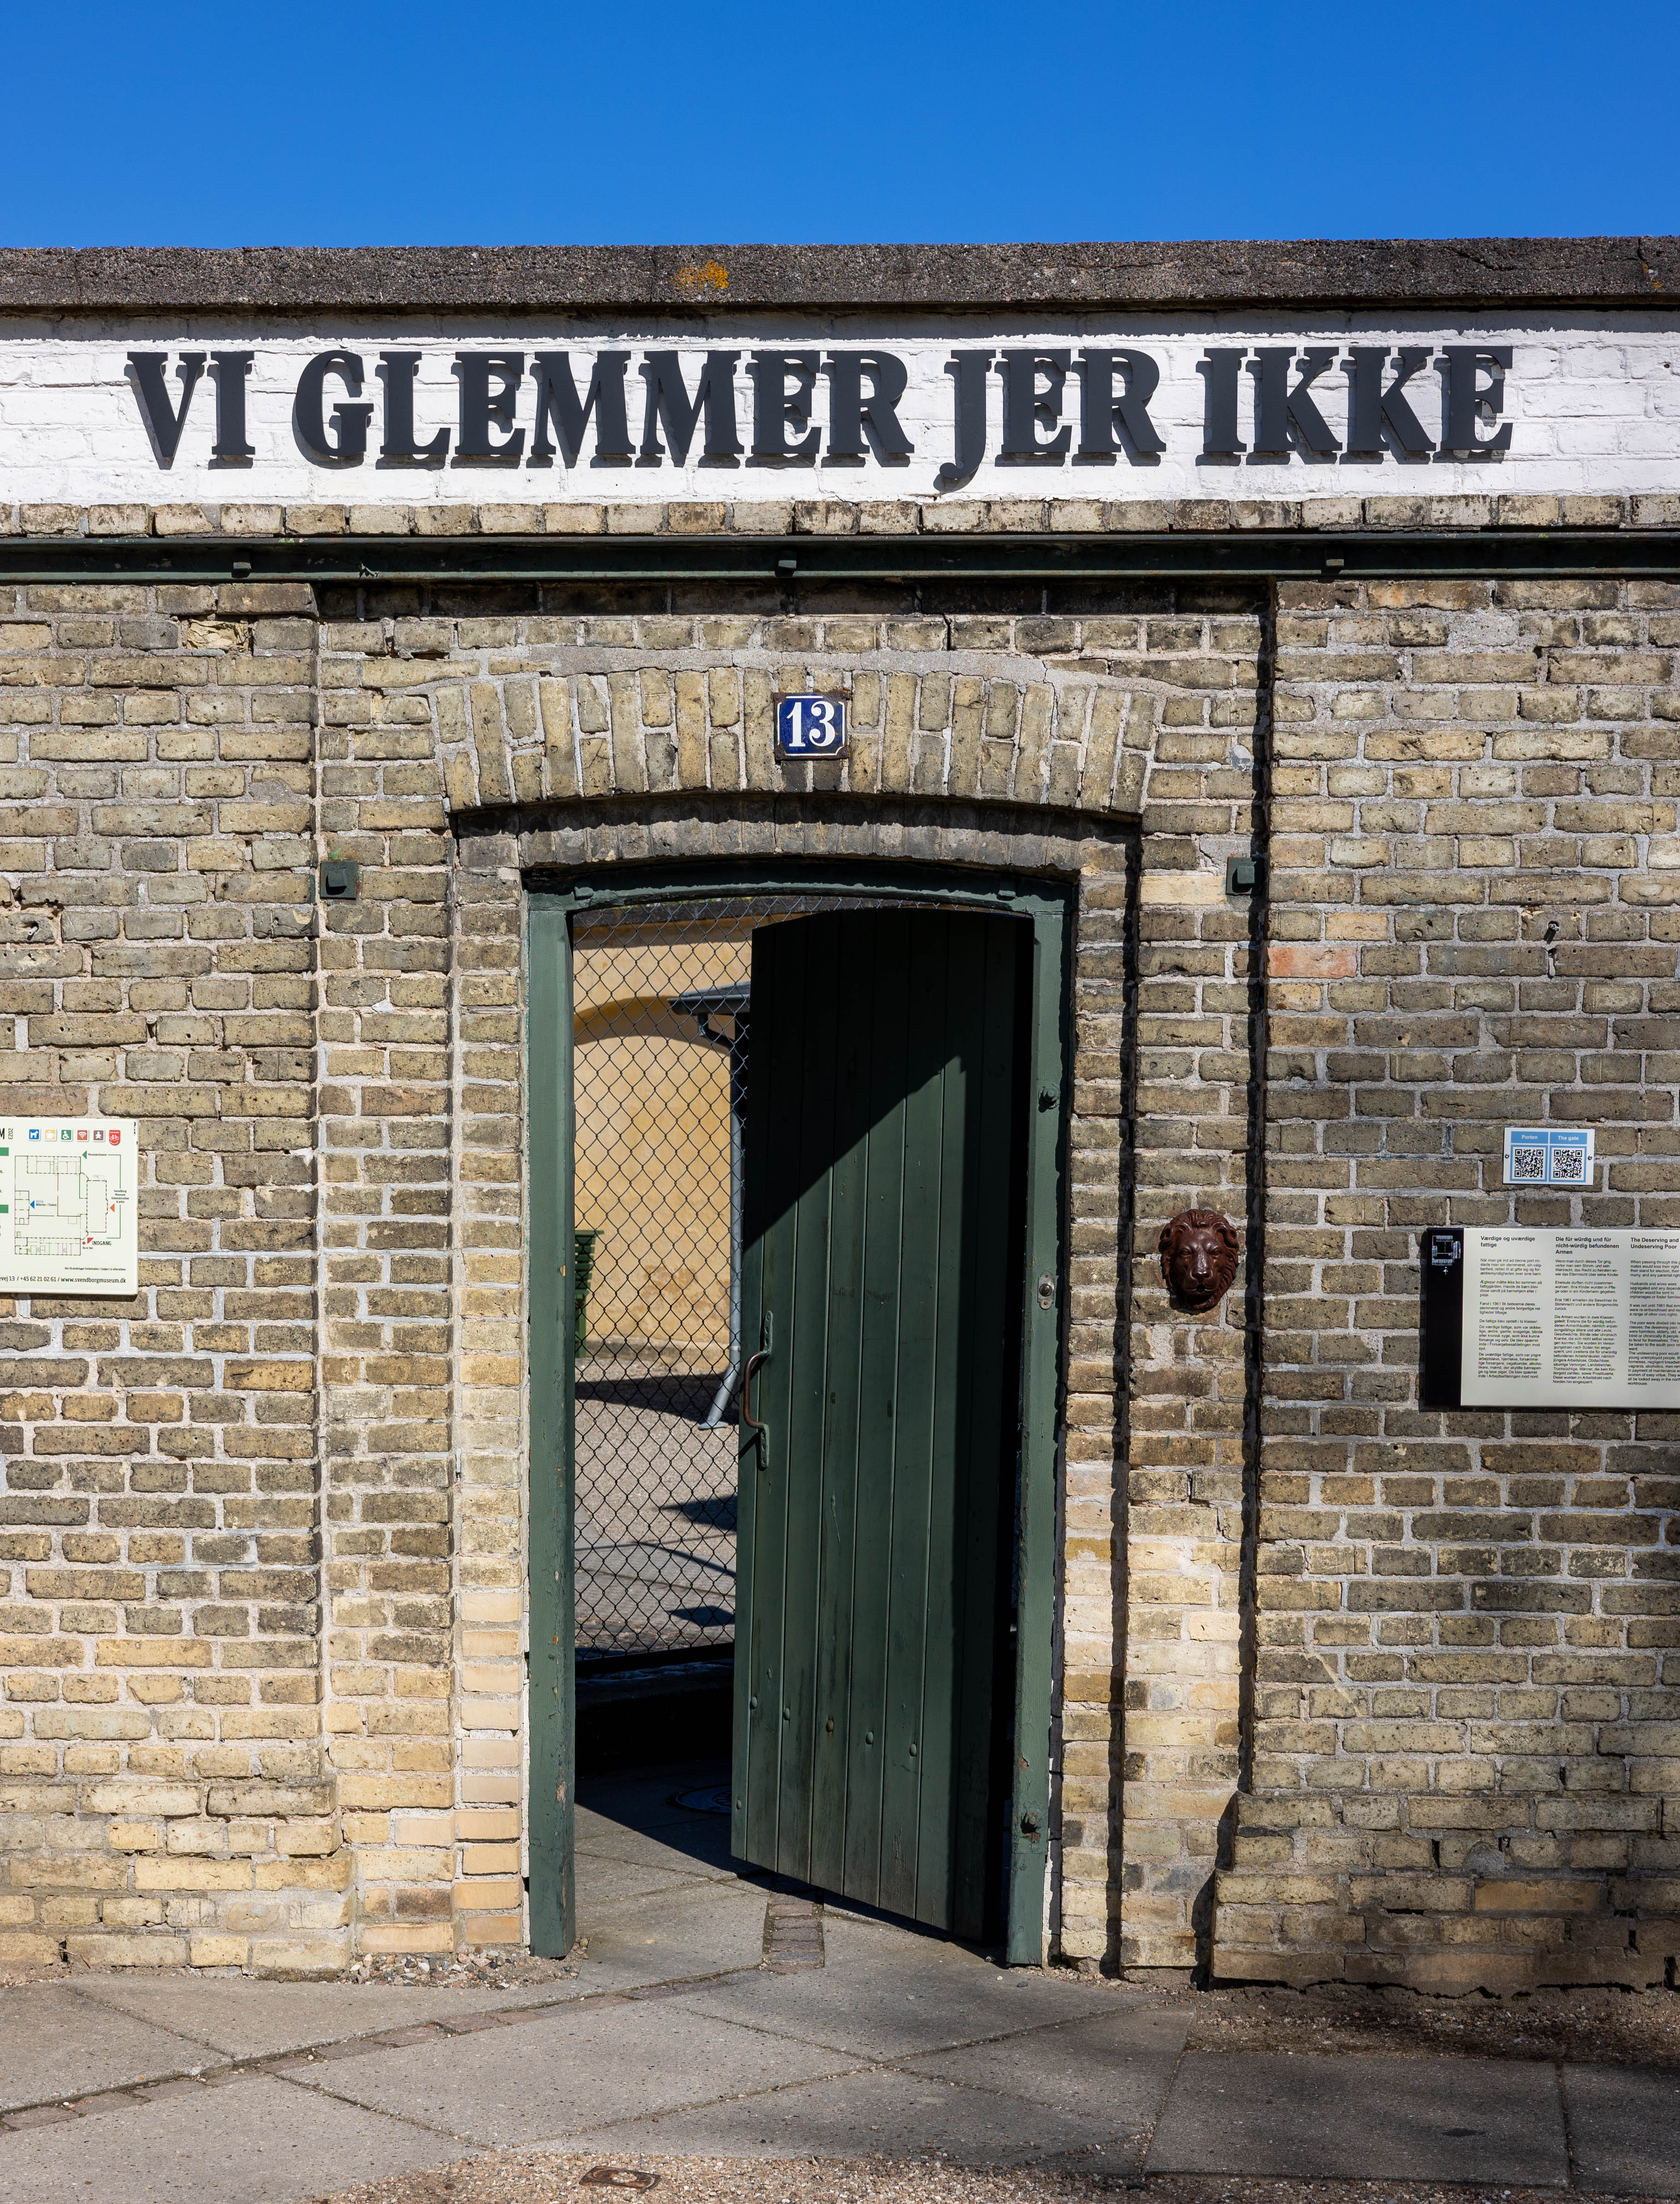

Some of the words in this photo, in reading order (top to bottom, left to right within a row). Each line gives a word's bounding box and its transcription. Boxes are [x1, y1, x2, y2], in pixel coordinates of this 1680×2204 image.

[127, 351, 255, 459] VI
[295, 350, 914, 457] GLEMMER
[940, 348, 1166, 479] JER
[1203, 346, 1513, 452] IKKE
[786, 701, 835, 747] 13
